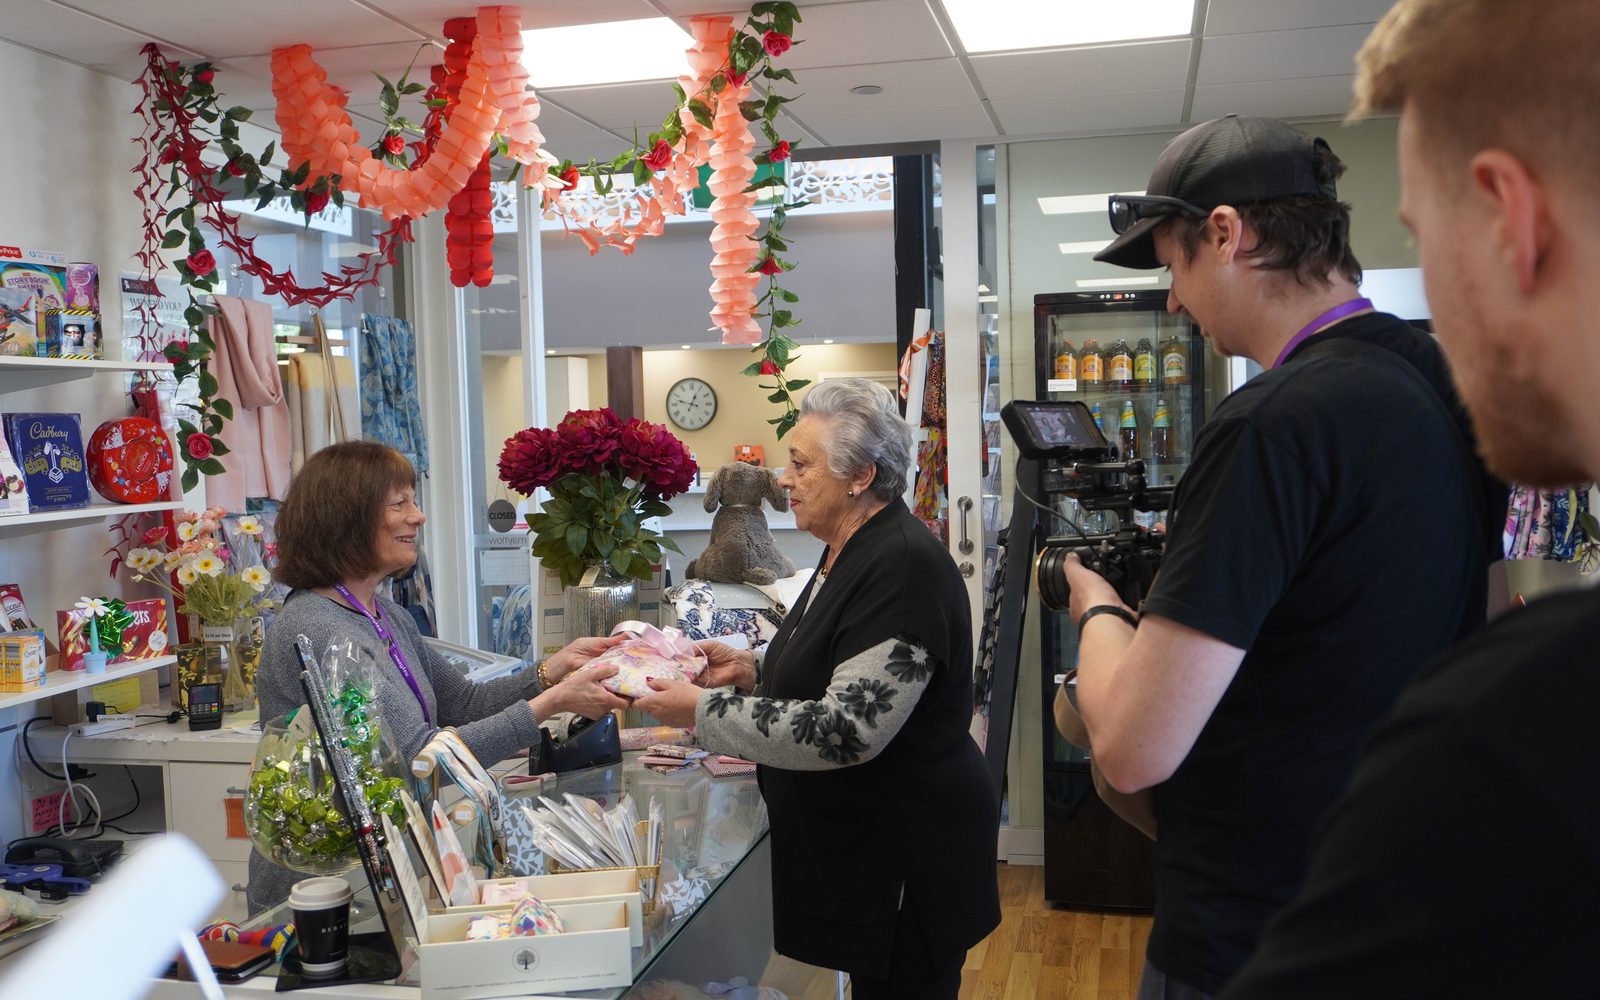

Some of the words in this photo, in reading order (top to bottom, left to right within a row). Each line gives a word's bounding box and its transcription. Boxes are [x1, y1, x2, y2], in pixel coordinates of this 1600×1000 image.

[30, 422, 69, 441] Cadbury
[135, 451, 150, 473] LINDOR
[488, 512, 516, 520] CLOSED
